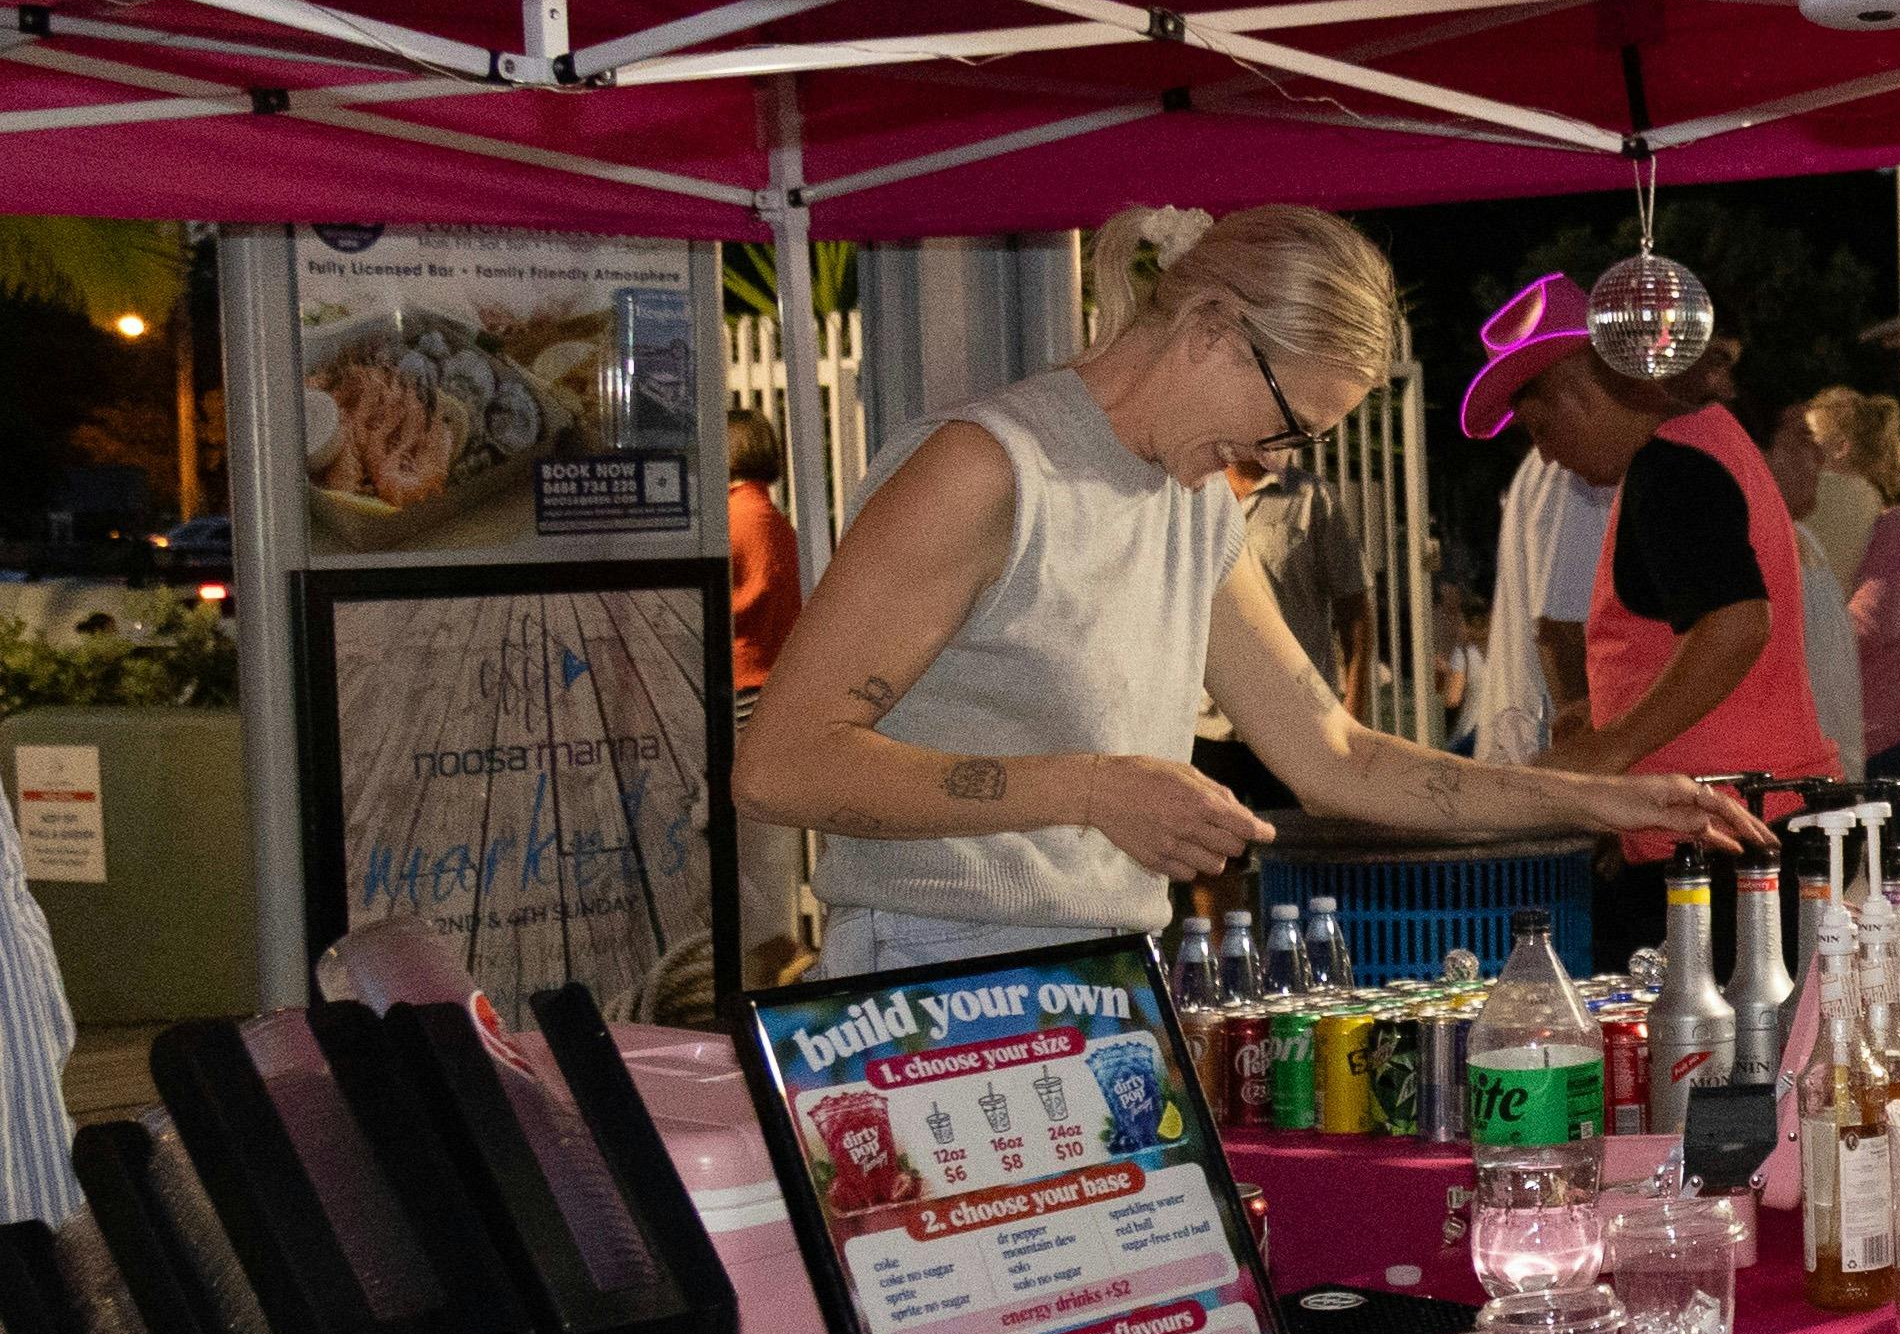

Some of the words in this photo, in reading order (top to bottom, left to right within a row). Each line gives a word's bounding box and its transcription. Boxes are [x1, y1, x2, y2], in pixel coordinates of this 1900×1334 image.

[541, 464, 590, 479] BOOK
[595, 463, 635, 478] NOW
[435, 913, 480, 935] 2ND
[488, 910, 501, 929] &
[553, 893, 639, 921] SUNDAY
[793, 989, 920, 1072] build
[918, 984, 1029, 1040] your
[1038, 983, 1131, 1019] own
[879, 1064, 900, 1084] 1.
[904, 1050, 982, 1079] choose
[984, 1043, 1029, 1070] your
[1032, 1033, 1071, 1055] size
[1114, 1075, 1146, 1097] dirty
[1119, 1090, 1147, 1112] pop
[843, 1126, 878, 1151] dirty
[990, 1136, 1024, 1151] 16oz
[1048, 1125, 1083, 1141] 24oz
[849, 1140, 879, 1163] pop
[933, 1148, 967, 1163] 12oz
[1055, 1143, 1084, 1161] $10
[1002, 1154, 1024, 1172] $8
[945, 1166, 967, 1183] $6
[922, 1211, 947, 1234] 2.
[950, 1195, 1028, 1227] choose
[1030, 1180, 1080, 1212] your
[1083, 1170, 1130, 1198] base
[1109, 1199, 1156, 1220] sparkling
[1157, 1193, 1184, 1208] water
[1116, 1223, 1133, 1237] red
[1135, 1218, 1153, 1232] bull
[1122, 1231, 1172, 1252] sugar-free
[1173, 1225, 1190, 1239] red
[1191, 1220, 1211, 1235] bull
[874, 1258, 899, 1272] coke
[880, 1274, 905, 1288] coke
[907, 1270, 922, 1283] no
[923, 1264, 954, 1280] sugar
[1002, 1304, 1051, 1328] energy
[1056, 1290, 1103, 1314] drinks
[1105, 1279, 1130, 1298] +$2
